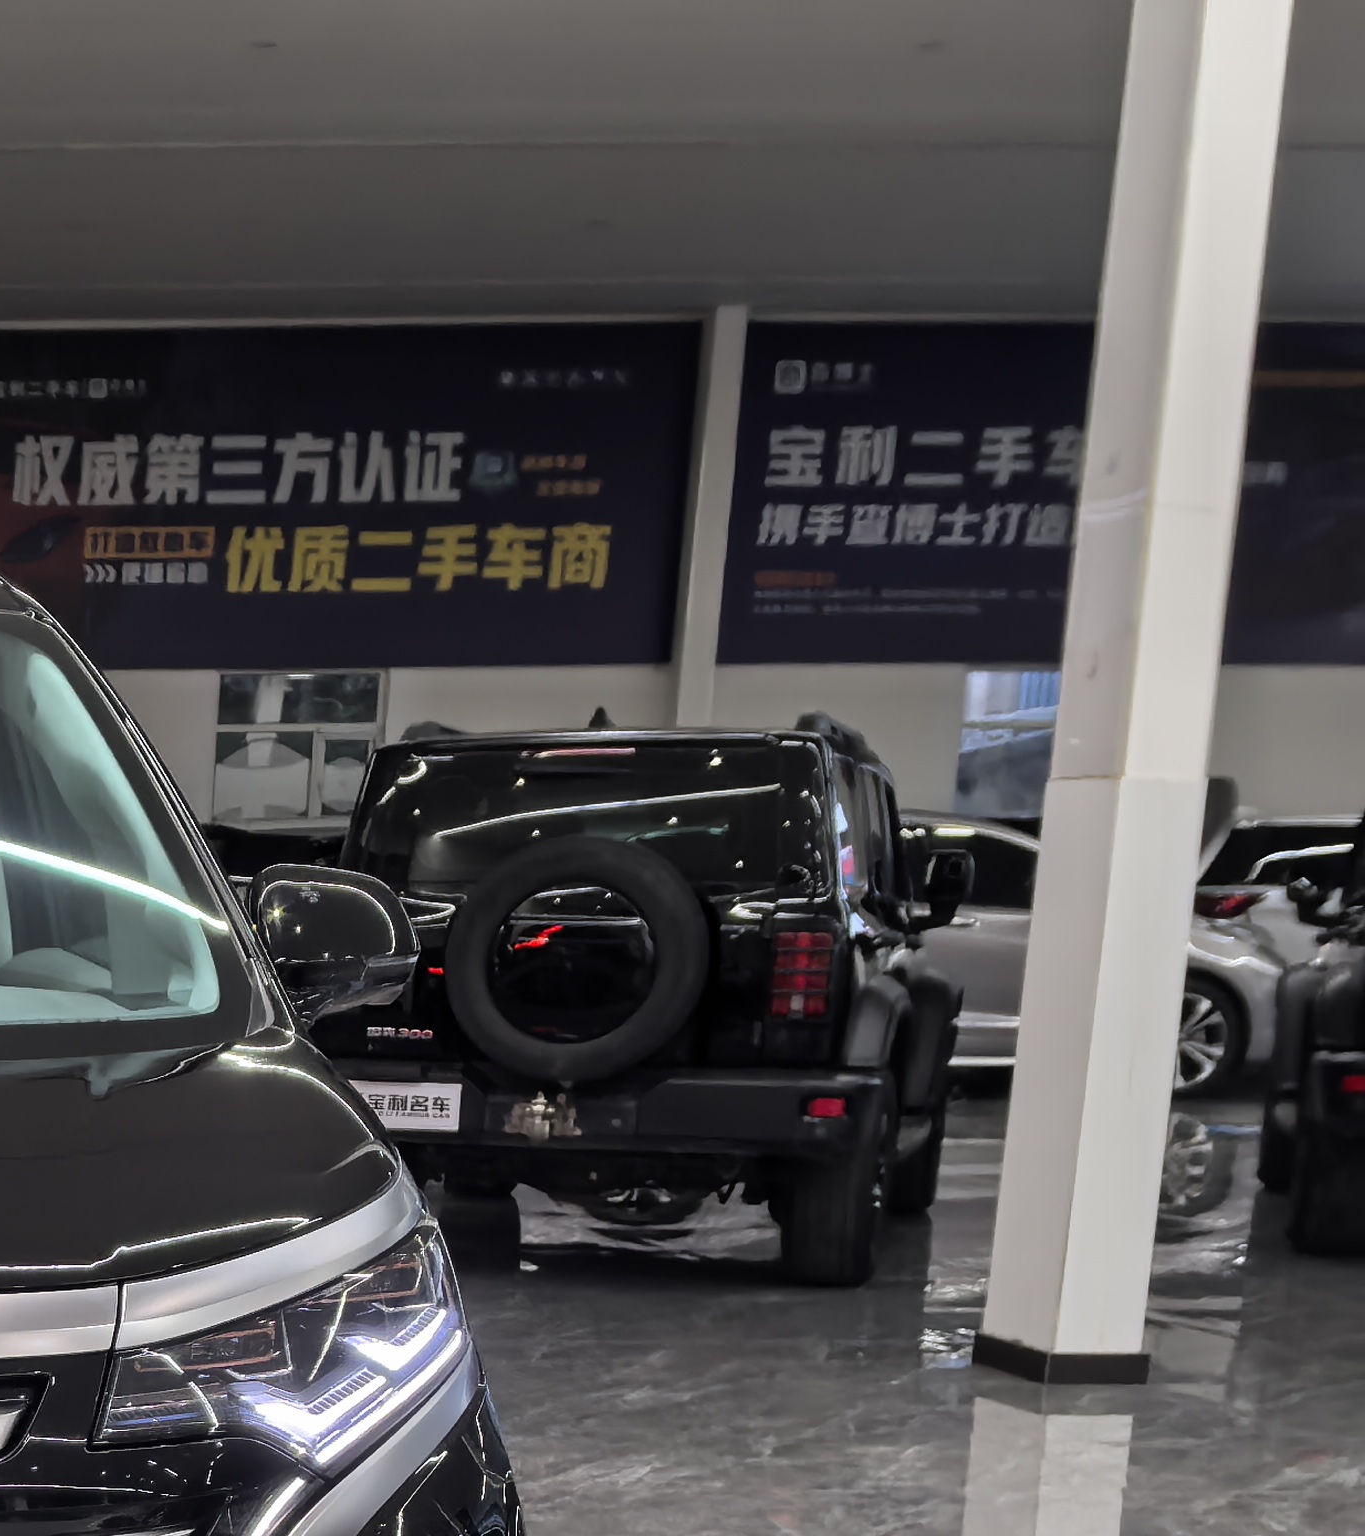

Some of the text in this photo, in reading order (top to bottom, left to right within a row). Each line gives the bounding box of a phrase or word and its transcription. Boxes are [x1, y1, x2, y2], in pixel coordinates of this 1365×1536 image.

[12, 431, 466, 507] 权威第三方认证
[764, 424, 1084, 488] 宝利二手车
[225, 522, 612, 594] 优质二手车商
[369, 1094, 451, 1112] 宝利名车
